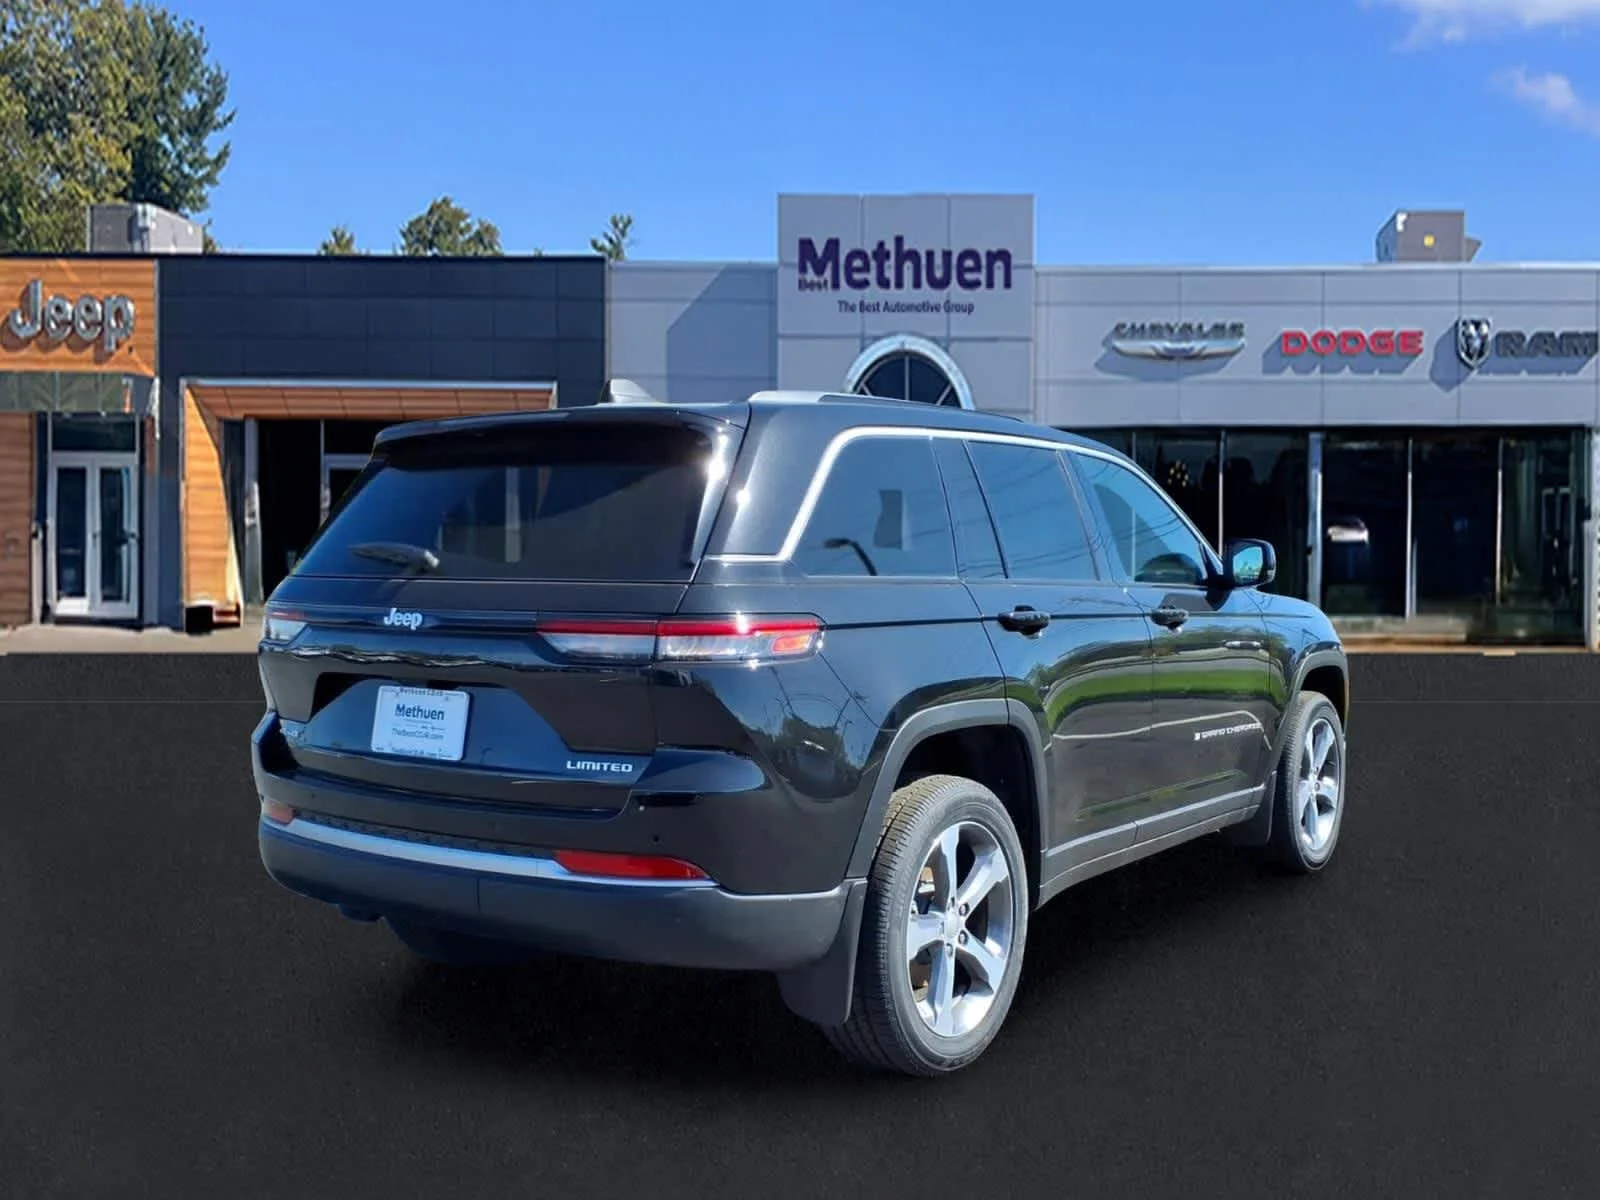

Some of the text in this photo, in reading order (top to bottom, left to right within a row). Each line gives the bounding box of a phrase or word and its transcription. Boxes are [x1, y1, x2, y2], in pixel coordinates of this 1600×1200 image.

[798, 235, 1012, 290] Methuen
[9, 279, 135, 352] Jeep
[838, 300, 975, 316] The Best Automotive Group
[1281, 329, 1424, 356] DODGE
[1495, 331, 1599, 358] RAM
[383, 607, 423, 630] Jeep
[394, 703, 445, 720] Methuen
[566, 760, 633, 773] LIMITED
